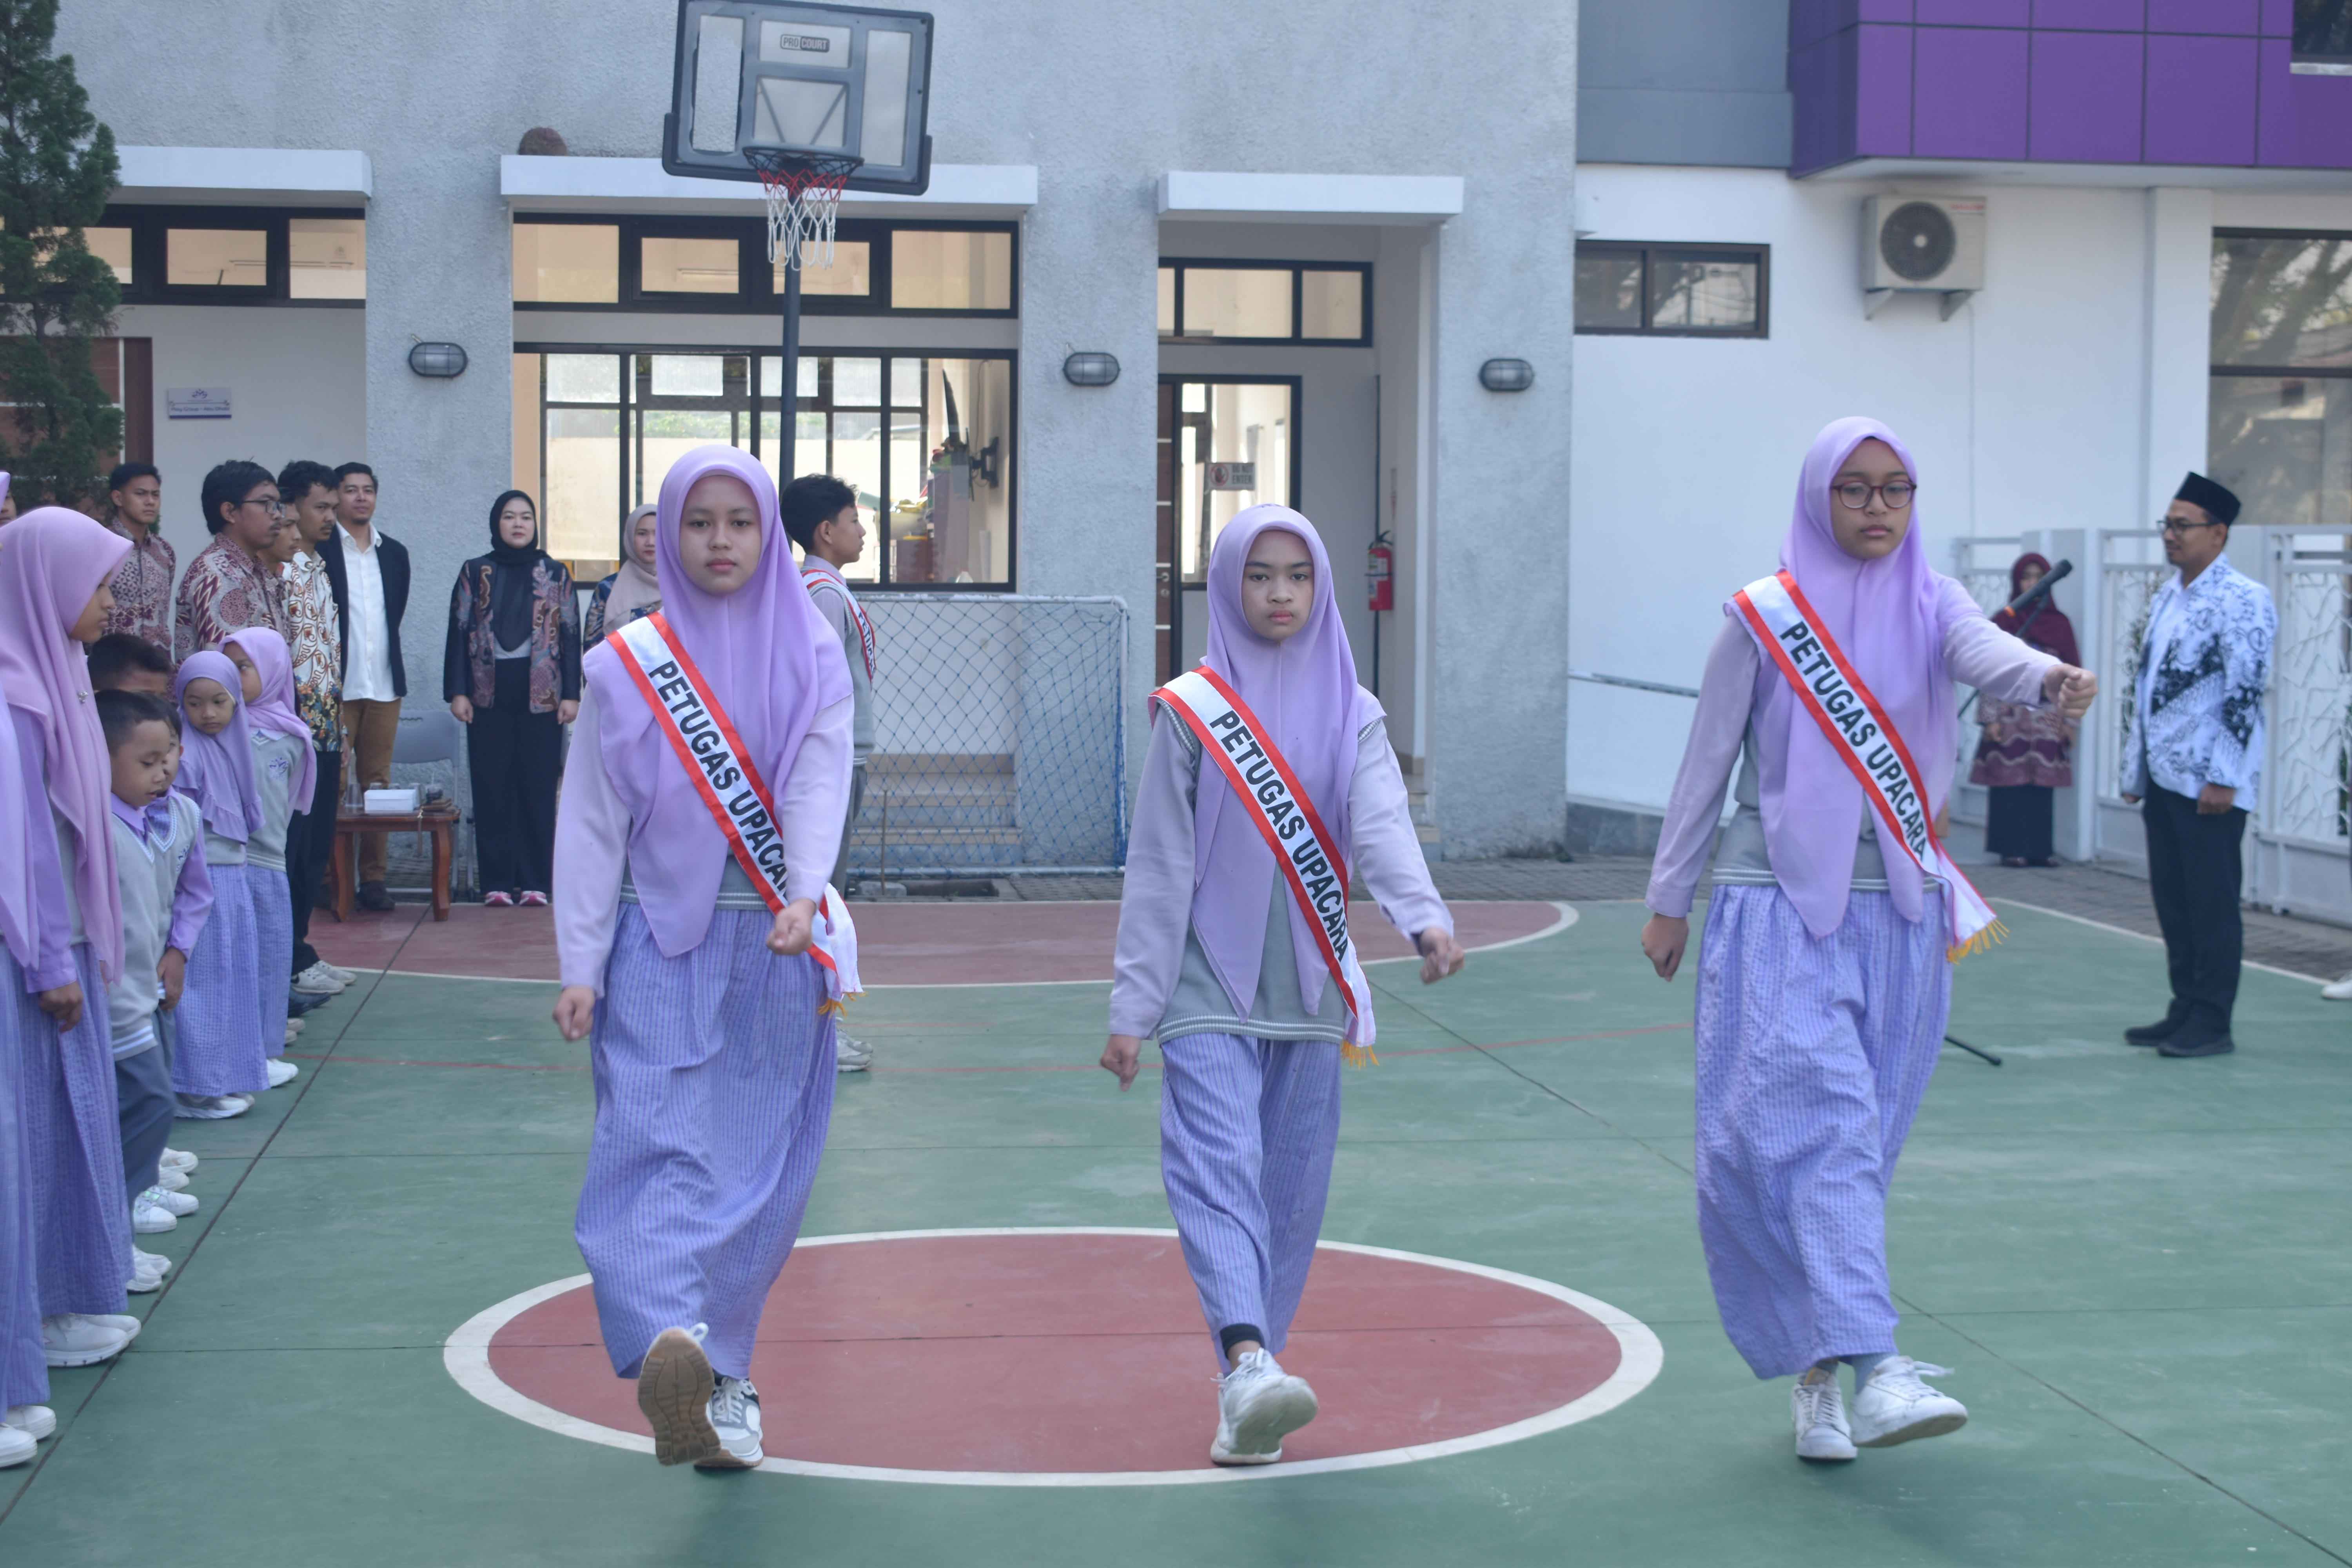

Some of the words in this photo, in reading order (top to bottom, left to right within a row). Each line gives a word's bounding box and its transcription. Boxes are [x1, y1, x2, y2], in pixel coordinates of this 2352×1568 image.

[784, 37, 799, 47] PRO
[802, 38, 828, 50] COURT
[1232, 464, 1240, 473] DO
[1242, 464, 1253, 473] NOT
[1232, 475, 1252, 484] ENTER
[648, 660, 740, 790] PETUGAS
[1780, 621, 1876, 746] PETUGAS
[1867, 743, 1926, 862] UPACARA
[1210, 710, 1305, 840] PETUGAS
[1292, 838, 1348, 962] UPACARA
